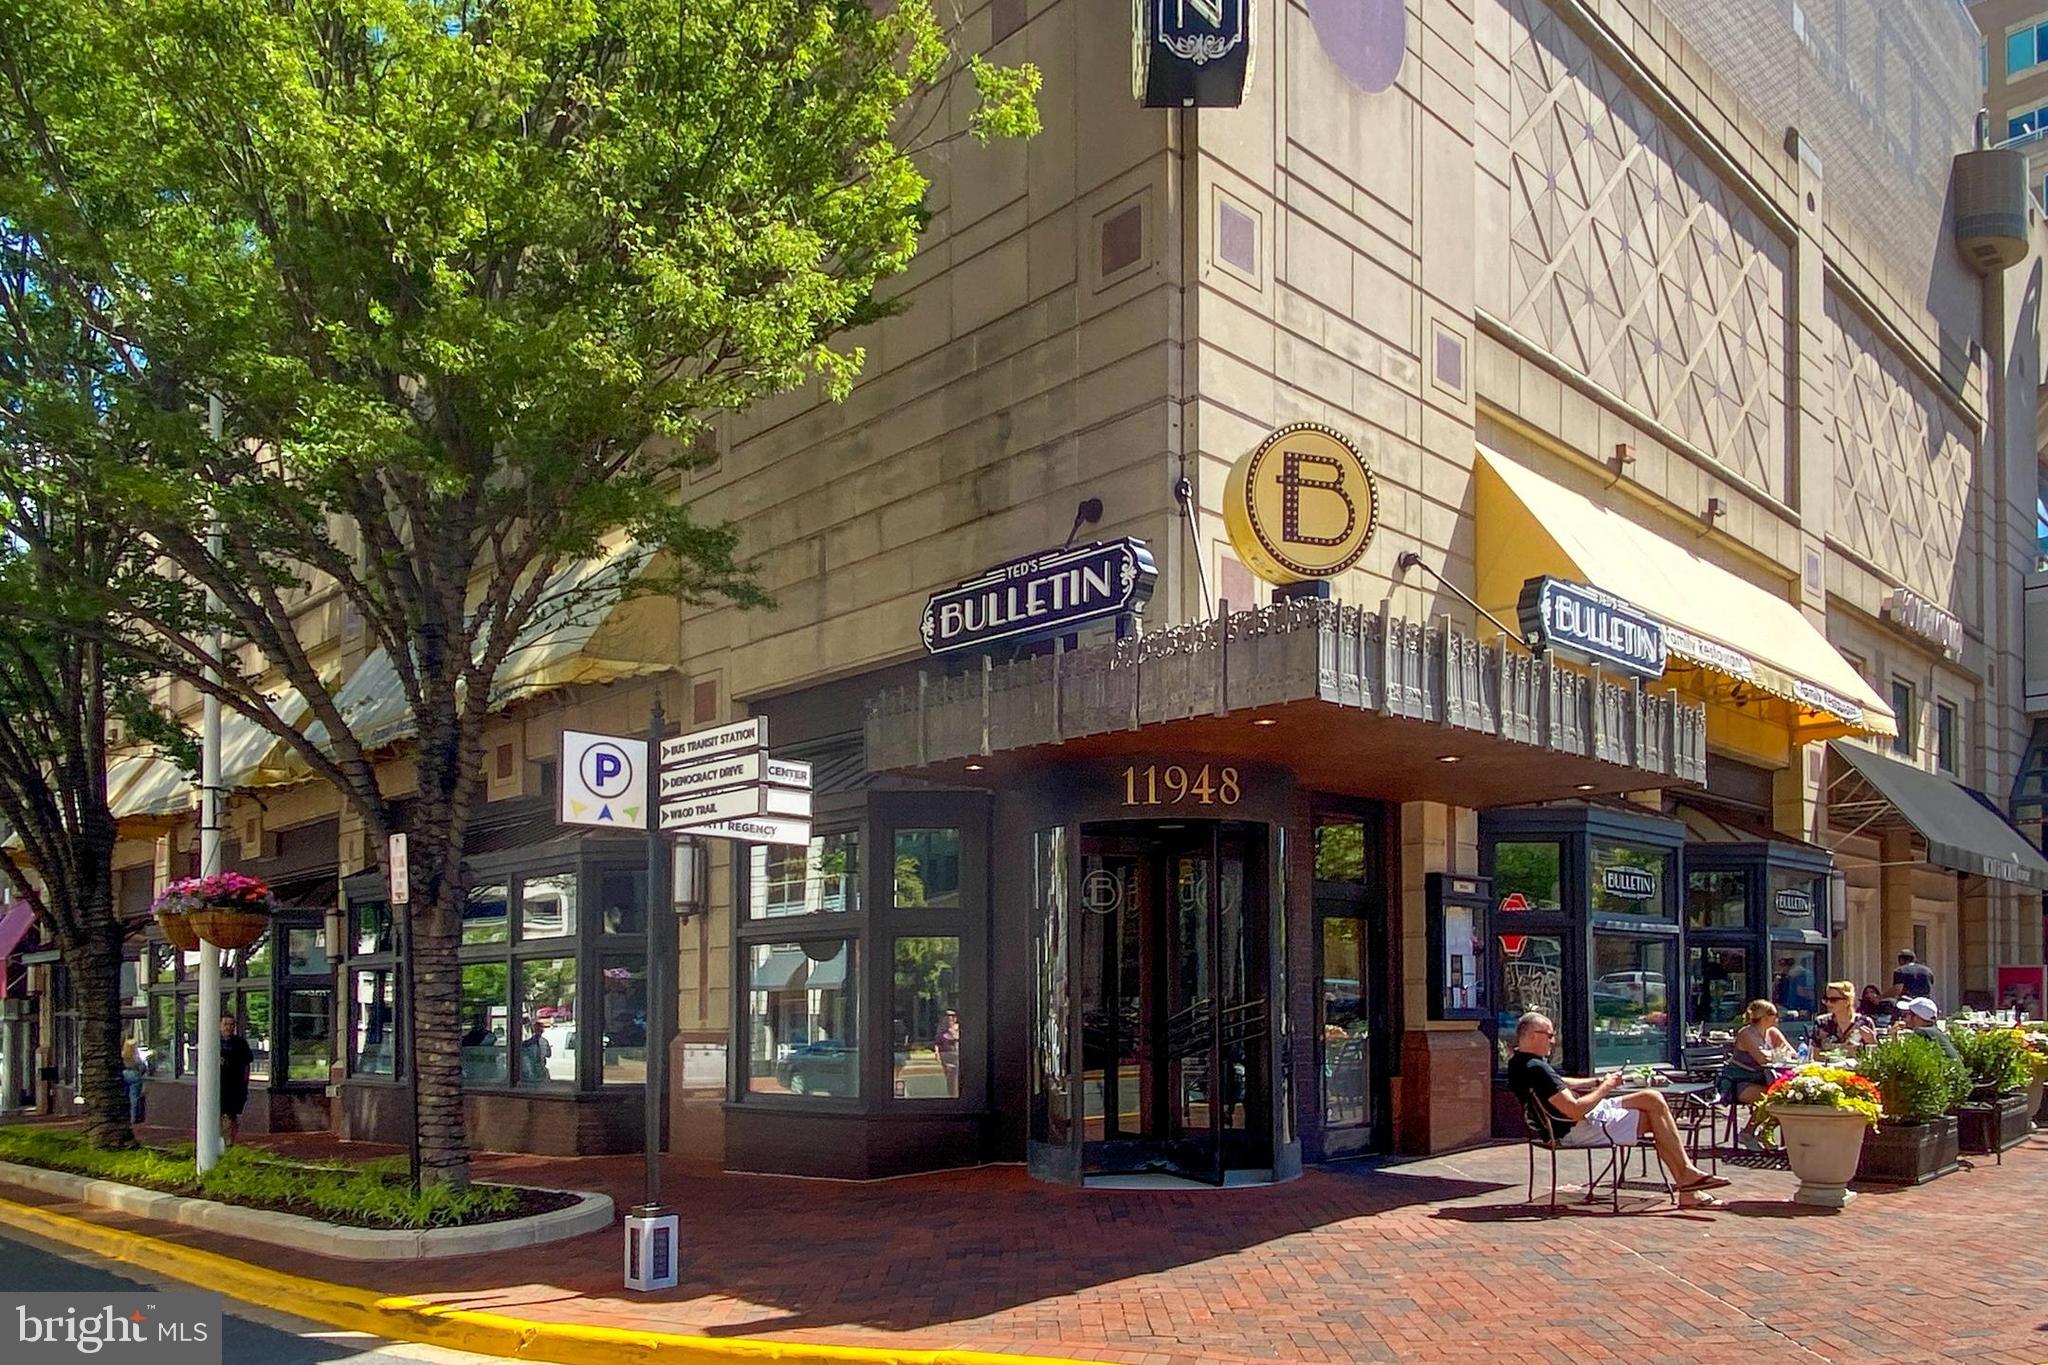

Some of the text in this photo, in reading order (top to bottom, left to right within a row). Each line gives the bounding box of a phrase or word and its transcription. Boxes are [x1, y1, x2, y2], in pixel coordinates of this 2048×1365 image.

[1276, 451, 1356, 547] B
[1006, 559, 1038, 579] TED'S
[940, 560, 1111, 639] BULLETIN
[1555, 595, 1657, 663] BULLETIN
[670, 727, 755, 756] BUS TRANSIT STATION
[596, 752, 621, 787] P
[670, 764, 744, 788] DEMOCRACY DRIVE
[768, 765, 808, 781] CENTER
[1121, 764, 1241, 806] 11948
[695, 803, 718, 815] TRAIL
[728, 821, 777, 835] REGENCY
[1607, 872, 1652, 892] BULLETIN
